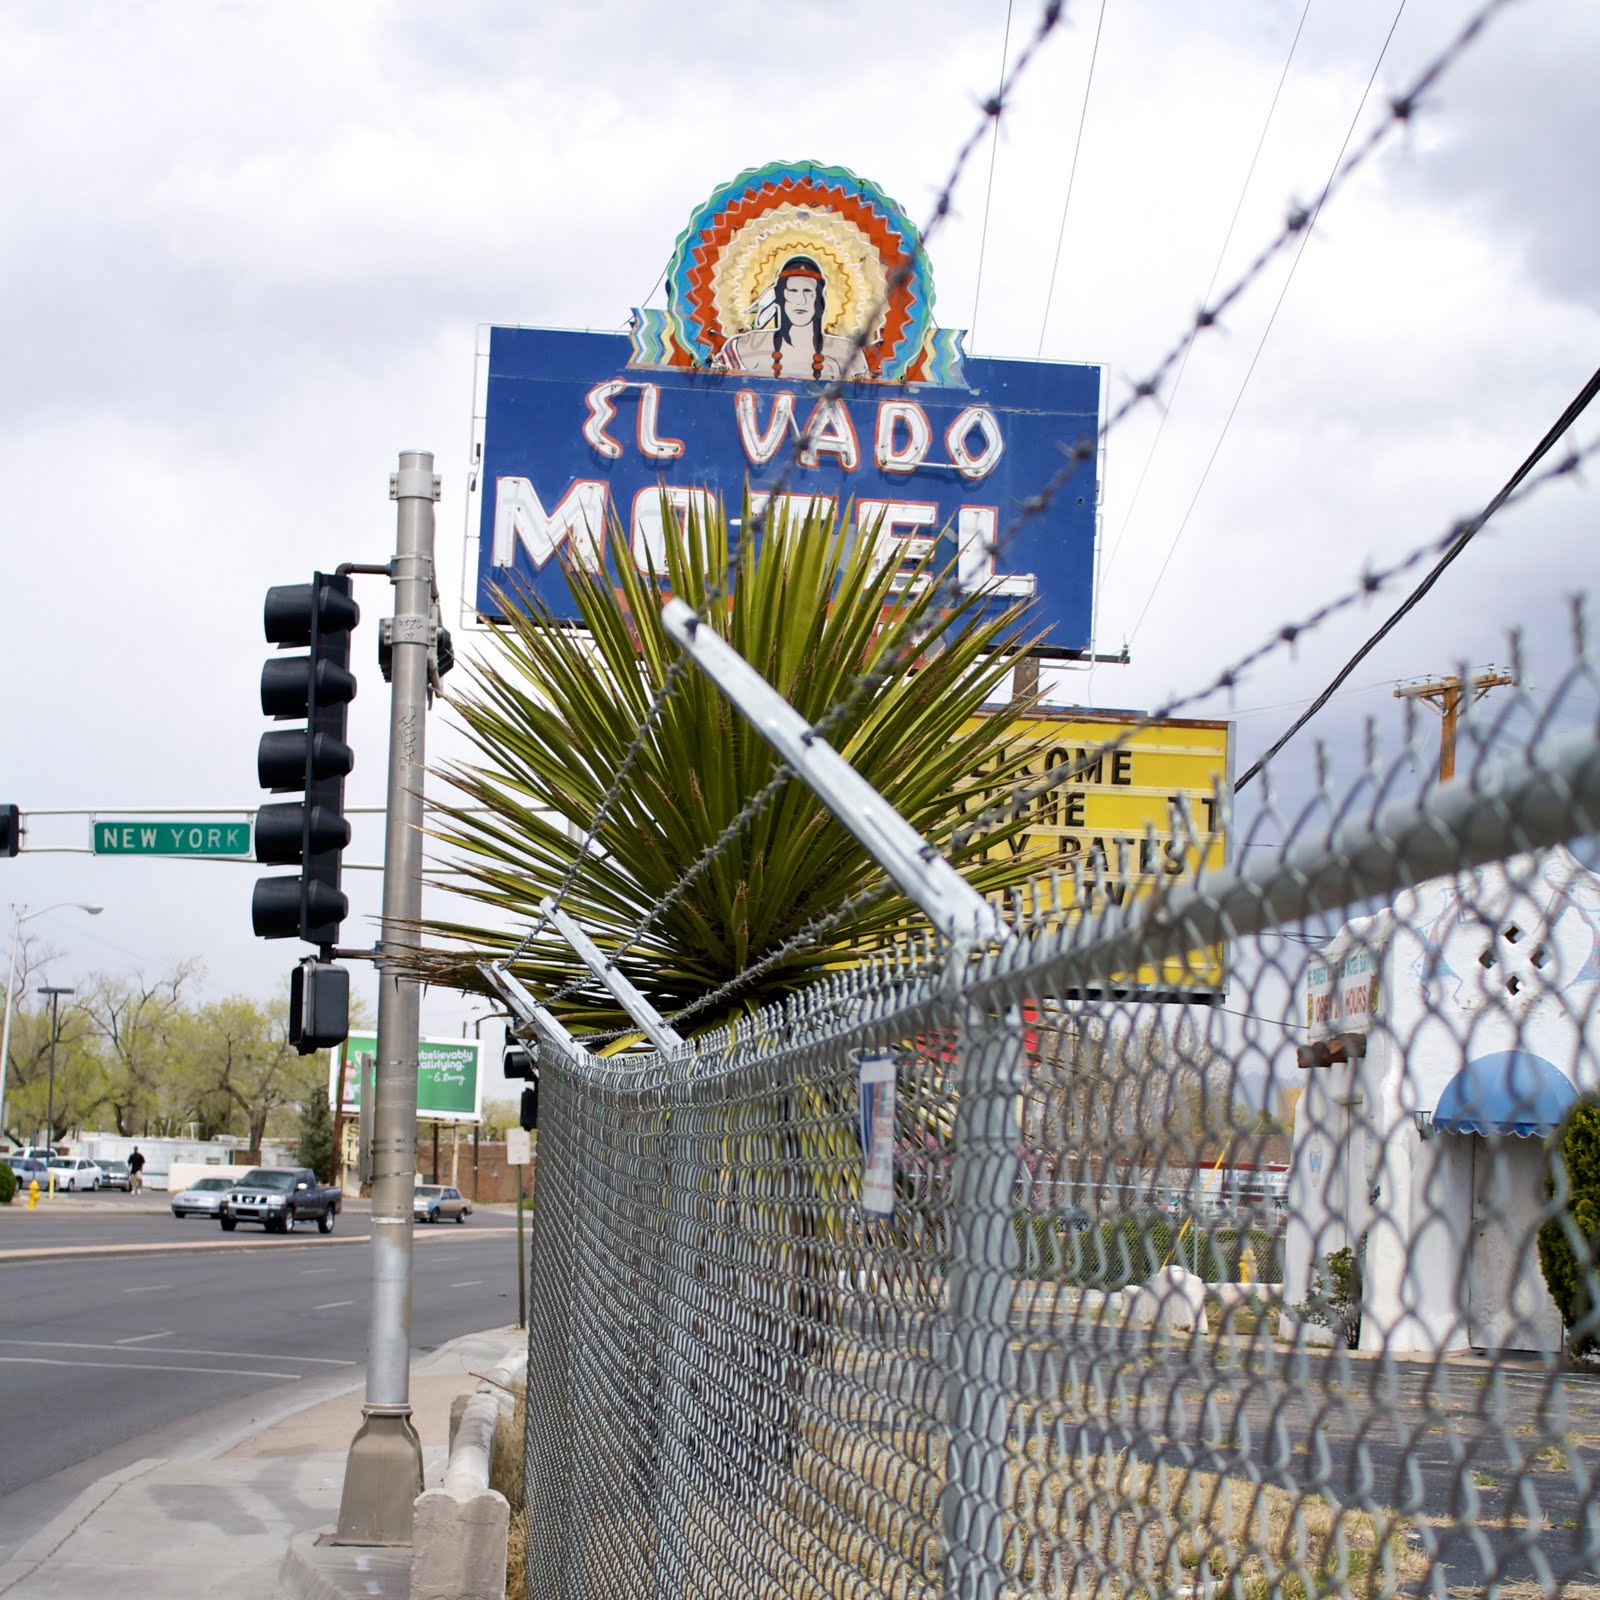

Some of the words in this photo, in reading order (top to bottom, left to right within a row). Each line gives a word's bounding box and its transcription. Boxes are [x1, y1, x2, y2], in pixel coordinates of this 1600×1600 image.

[584, 379, 685, 459] EL
[735, 389, 1004, 480] VADO
[945, 741, 1132, 785] ECOME
[103, 828, 157, 848] NEW
[171, 828, 240, 848] YORK
[418, 1049, 473, 1062] believably
[418, 1059, 468, 1072] atisfying."
